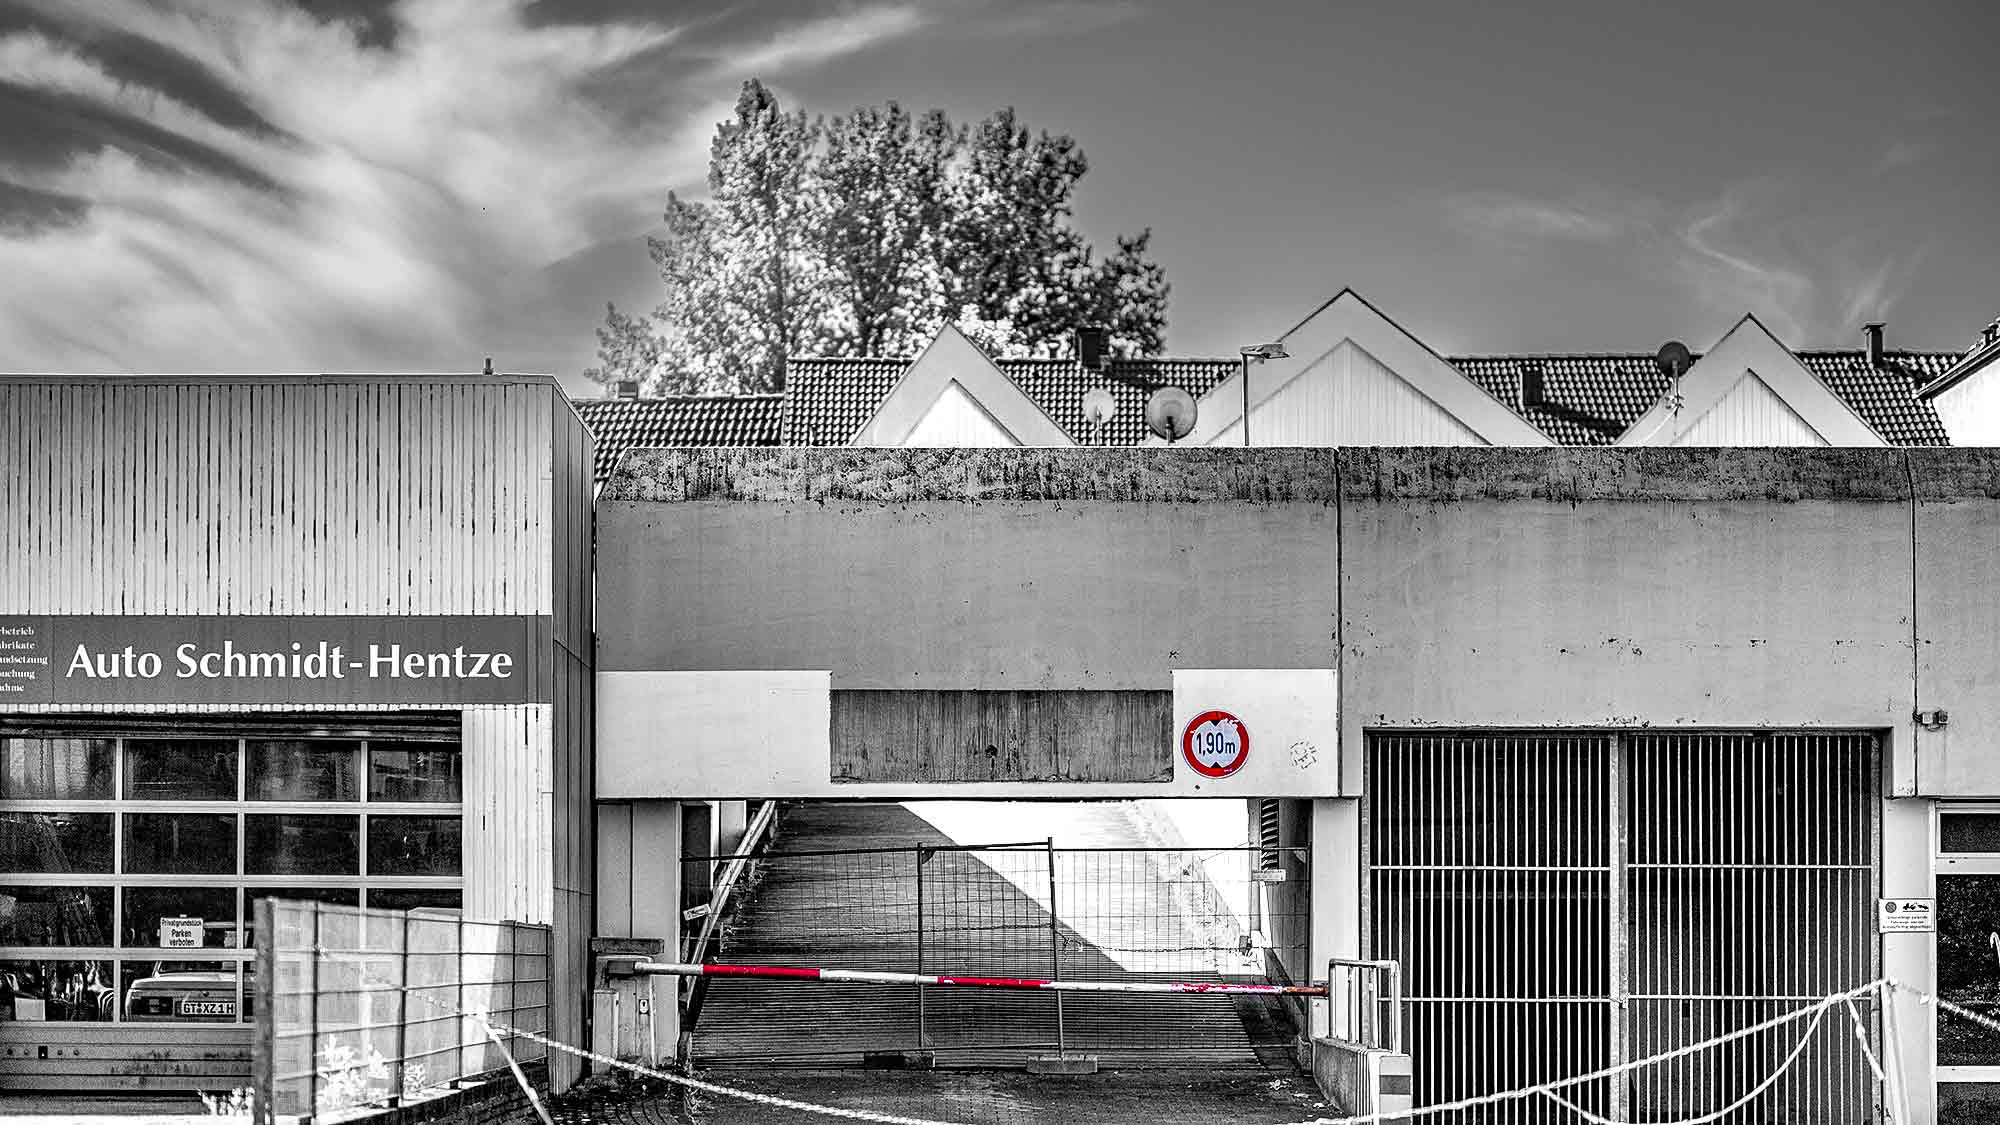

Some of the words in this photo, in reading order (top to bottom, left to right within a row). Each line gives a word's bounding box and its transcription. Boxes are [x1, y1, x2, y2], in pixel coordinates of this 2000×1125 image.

[0, 640, 35, 650] brikate
[66, 643, 162, 679] Auto
[176, 640, 513, 679] Schmidt-Hentze
[0, 669, 36, 680] uchung
[161, 919, 202, 927] Privatgrundstück
[171, 929, 192, 937] Parken
[169, 938, 195, 946] verboten
